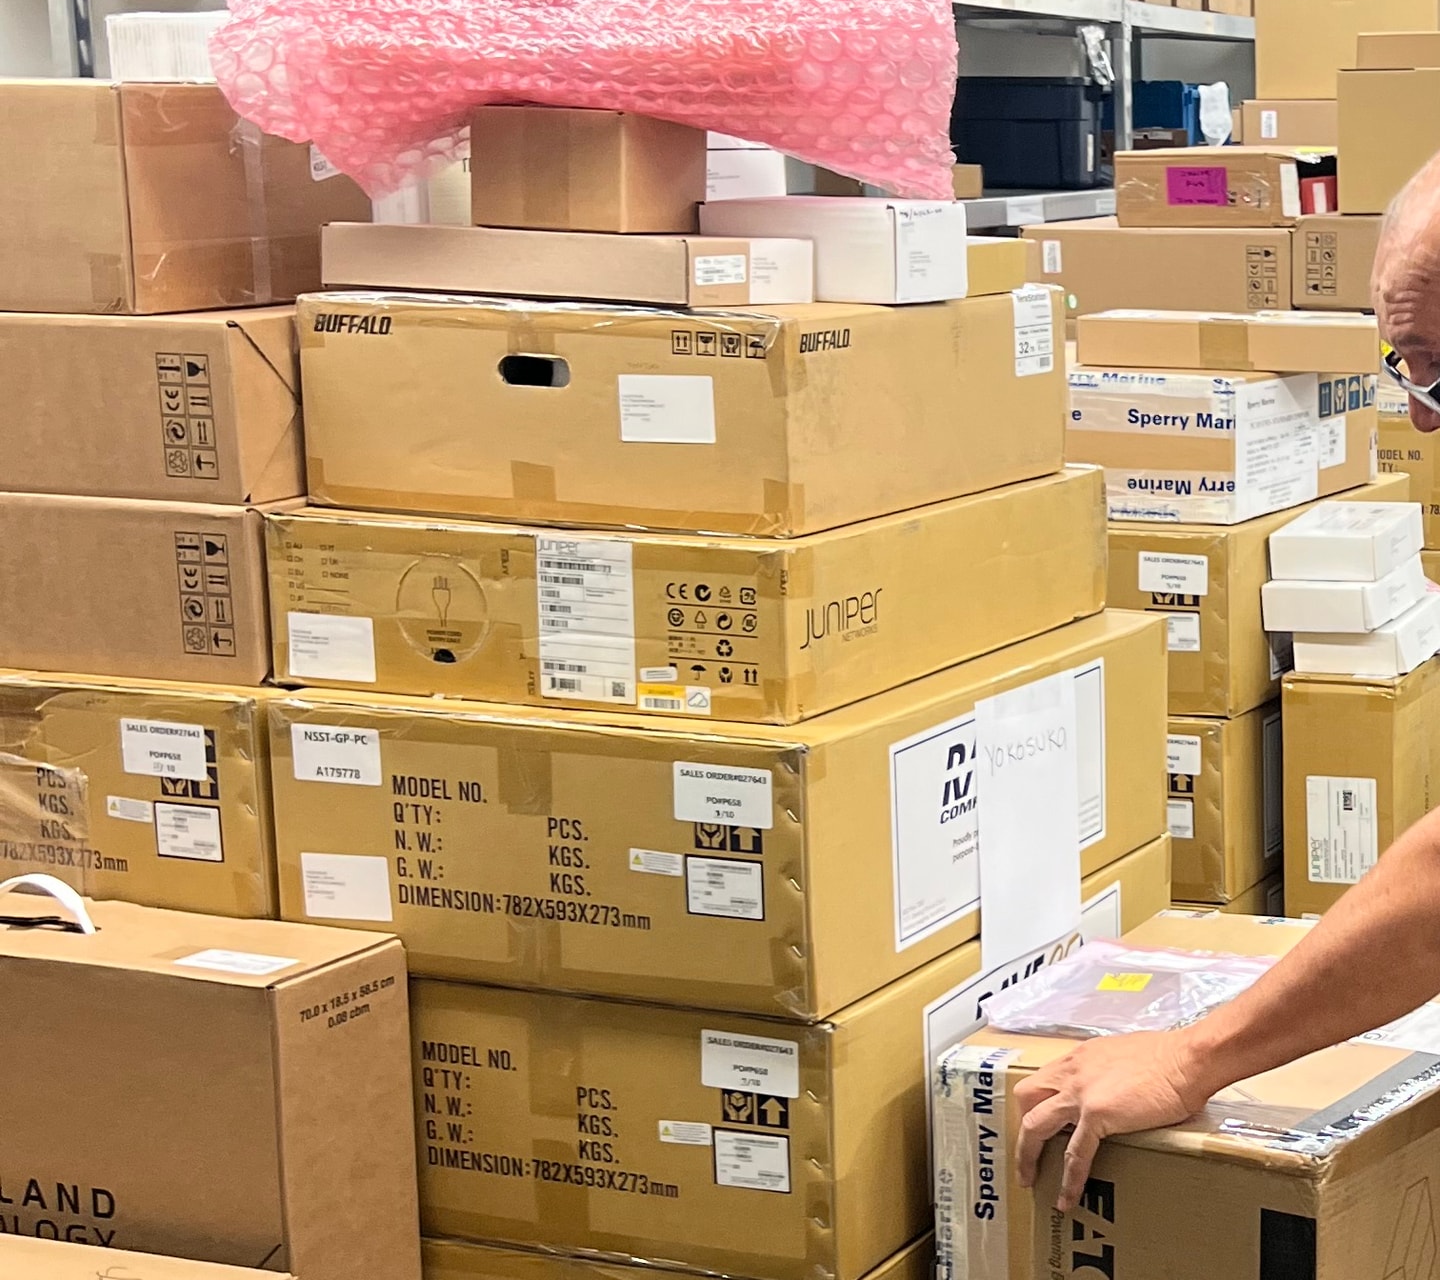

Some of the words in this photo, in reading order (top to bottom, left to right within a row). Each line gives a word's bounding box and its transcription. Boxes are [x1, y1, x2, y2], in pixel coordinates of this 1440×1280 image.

[314, 314, 392, 335] BUFFALO
[800, 328, 850, 354] BUFFALO
[1018, 341, 1030, 354] 32
[1127, 409, 1189, 430] Sperry
[1128, 478, 1191, 495] Marine
[127, 724, 148, 733] SALES
[304, 730, 368, 745] NSST-GP-PC
[316, 766, 361, 780] A179778
[680, 769, 704, 779] SALES
[392, 774, 452, 800] MODEL
[458, 781, 488, 803] NO.
[38, 792, 74, 816] KGS.
[393, 802, 441, 825] Q'TY:
[40, 819, 76, 841] KGS.
[547, 817, 589, 841] PCS.
[549, 845, 590, 870] KGS.
[550, 873, 591, 896] KGS.
[707, 1036, 731, 1046] SALES
[421, 1041, 481, 1067] MODEL
[489, 1048, 517, 1071] NO.
[424, 1067, 471, 1090] Q'TY:
[576, 1086, 618, 1111] PCS.
[578, 1114, 619, 1138] KGS.
[578, 1140, 620, 1164] KGS.
[973, 1122, 997, 1220] Sperry
[1048, 1207, 1065, 1268] Powering
